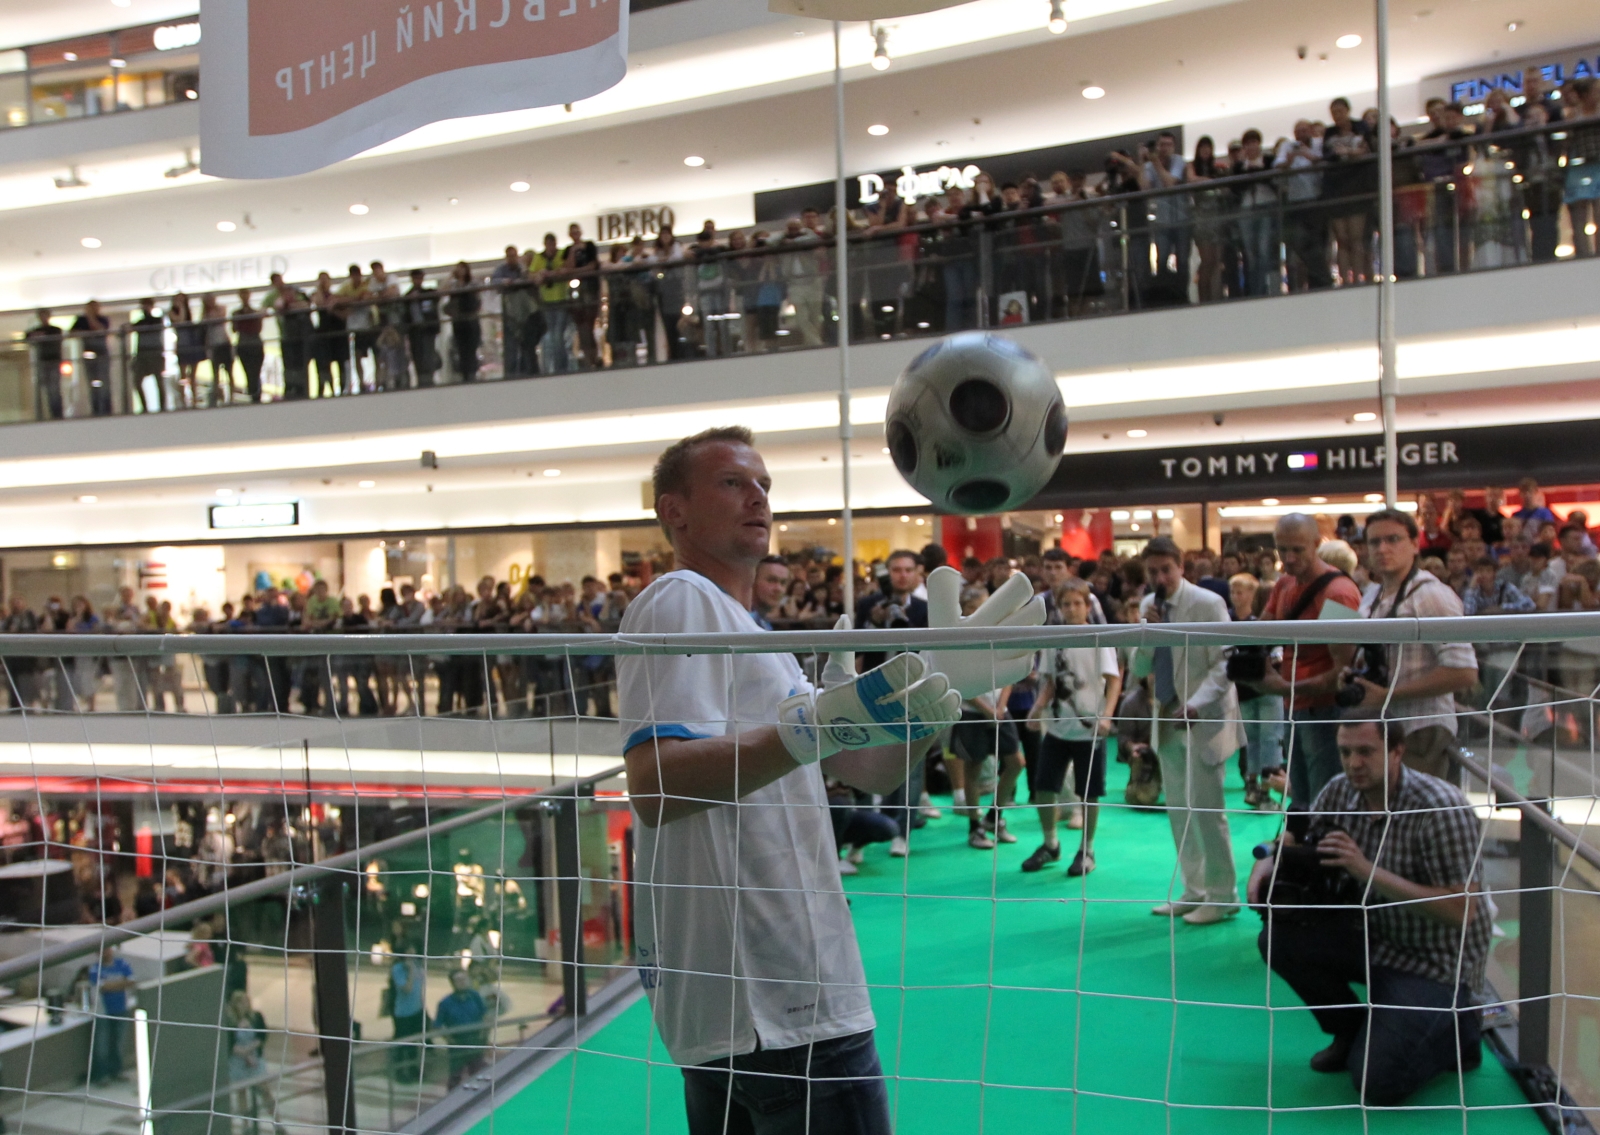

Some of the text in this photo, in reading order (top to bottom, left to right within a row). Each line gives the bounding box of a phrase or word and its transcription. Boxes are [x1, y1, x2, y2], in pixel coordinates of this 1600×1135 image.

[1452, 55, 1600, 102] FINN LA
[597, 206, 674, 242] IBERO
[149, 254, 289, 292] GLENFIELD
[1161, 441, 1459, 478] TOMMY HILFGER
